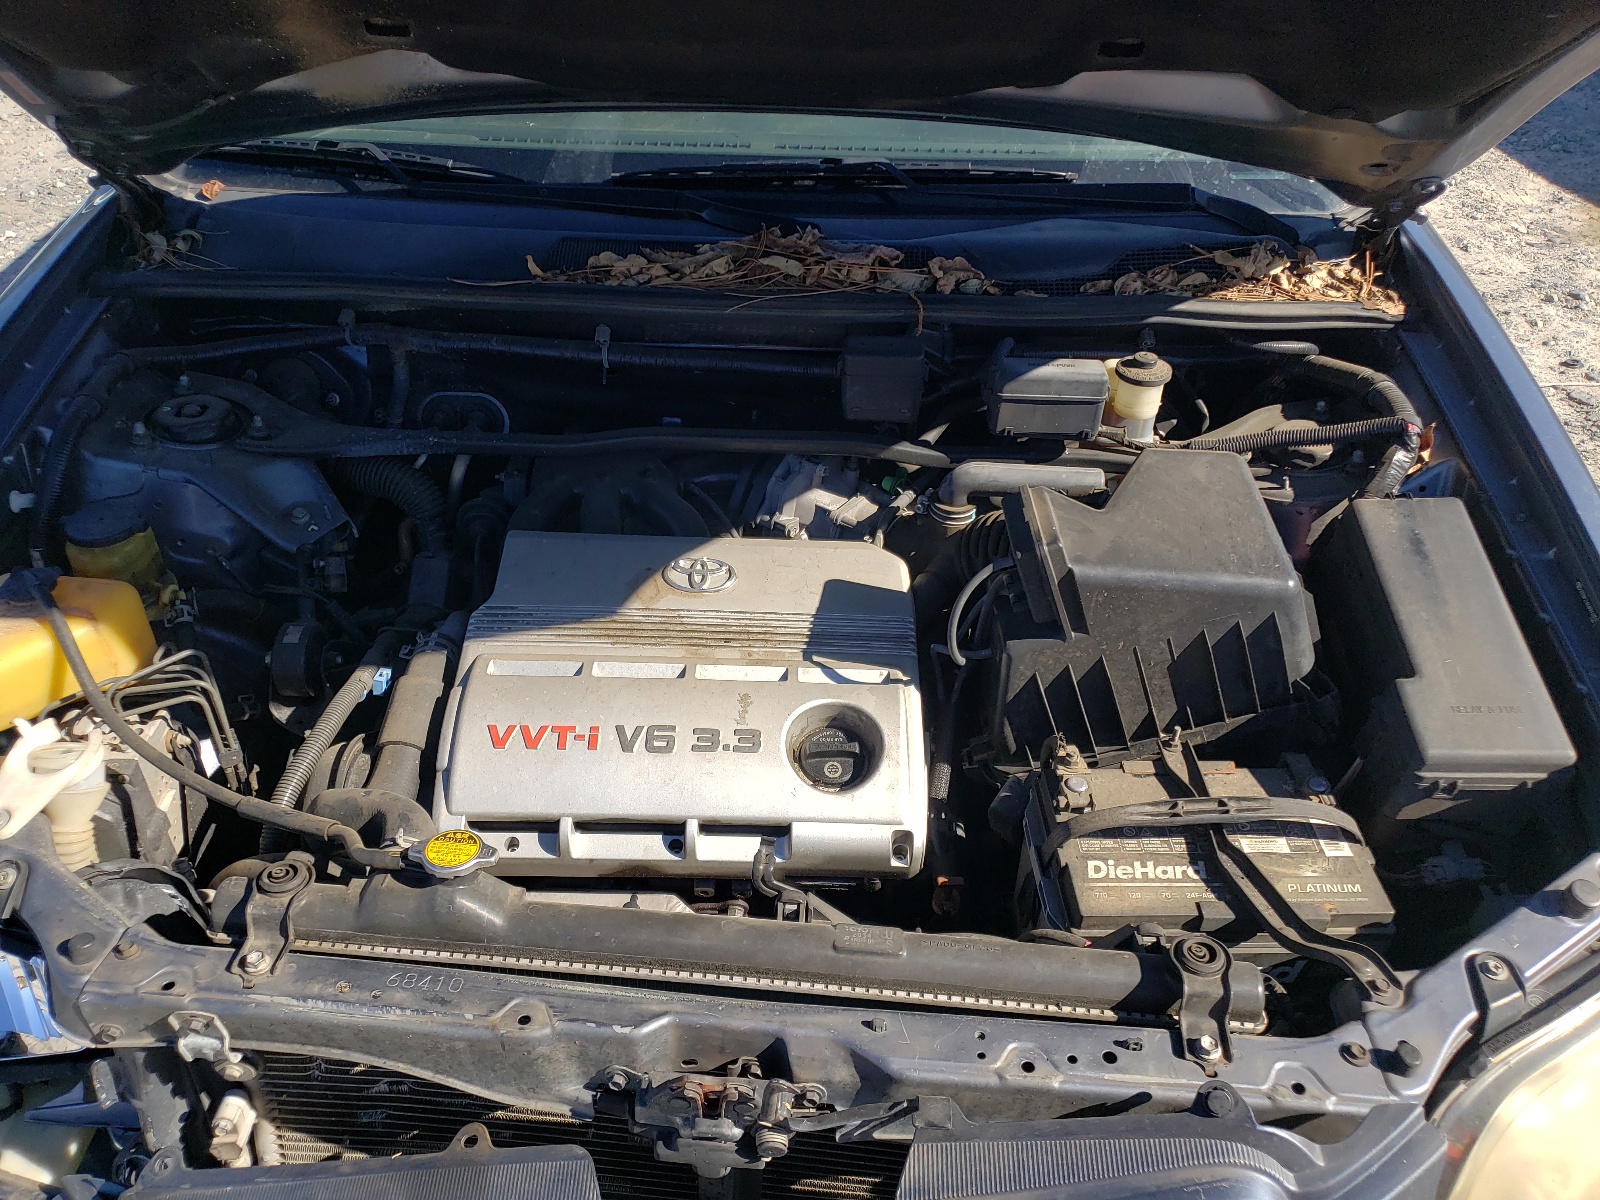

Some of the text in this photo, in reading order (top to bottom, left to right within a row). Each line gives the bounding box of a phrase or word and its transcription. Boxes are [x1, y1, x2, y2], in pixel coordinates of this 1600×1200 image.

[487, 725, 763, 754] VVT-i V6 3.3
[1087, 859, 1208, 880] DieHard
[1287, 883, 1363, 894] PLATINUM
[386, 971, 465, 993] 68410
